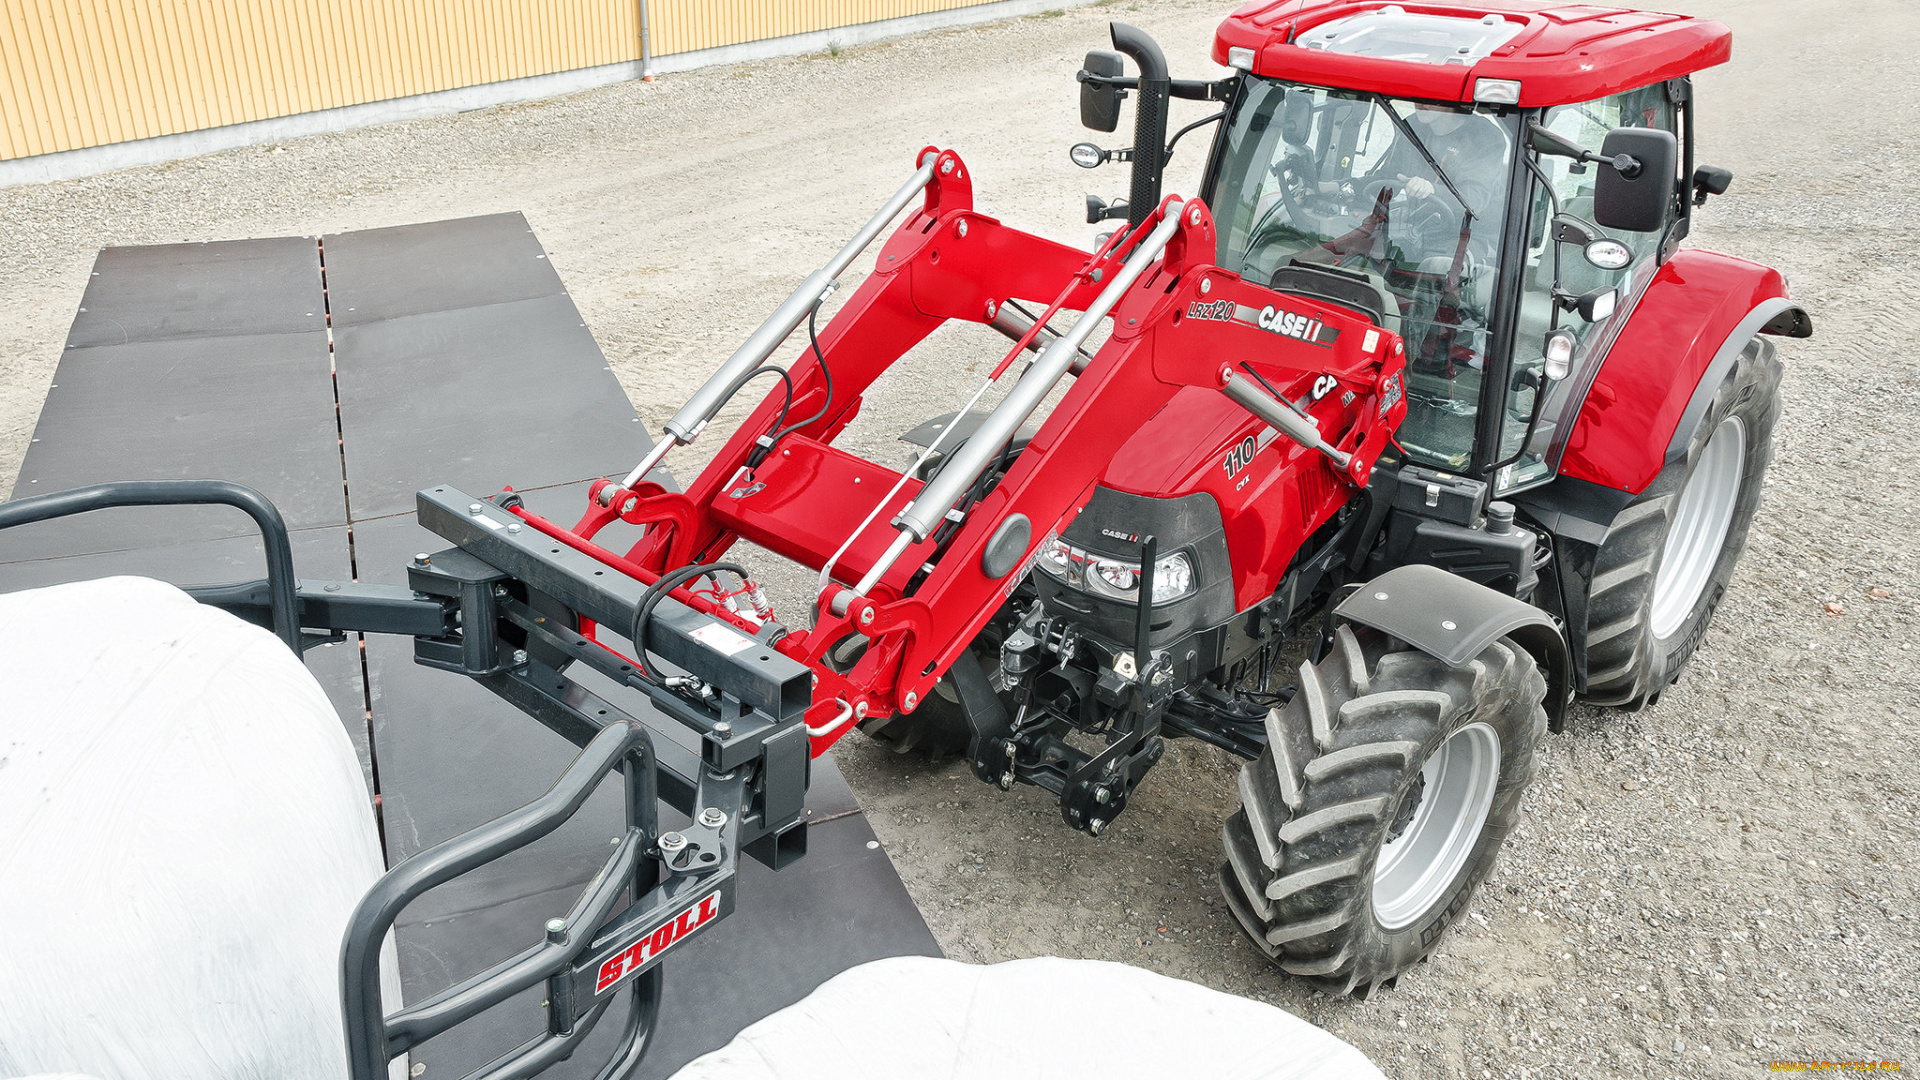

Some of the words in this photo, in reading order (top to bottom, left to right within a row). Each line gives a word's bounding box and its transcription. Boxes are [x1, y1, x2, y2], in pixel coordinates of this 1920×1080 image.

[1258, 304, 1308, 338] CASE
[1313, 374, 1338, 400] CA
[1223, 435, 1255, 480] 110
[1236, 474, 1251, 492] CVX
[1101, 528, 1129, 540] CASE
[597, 894, 717, 992] STOLL
